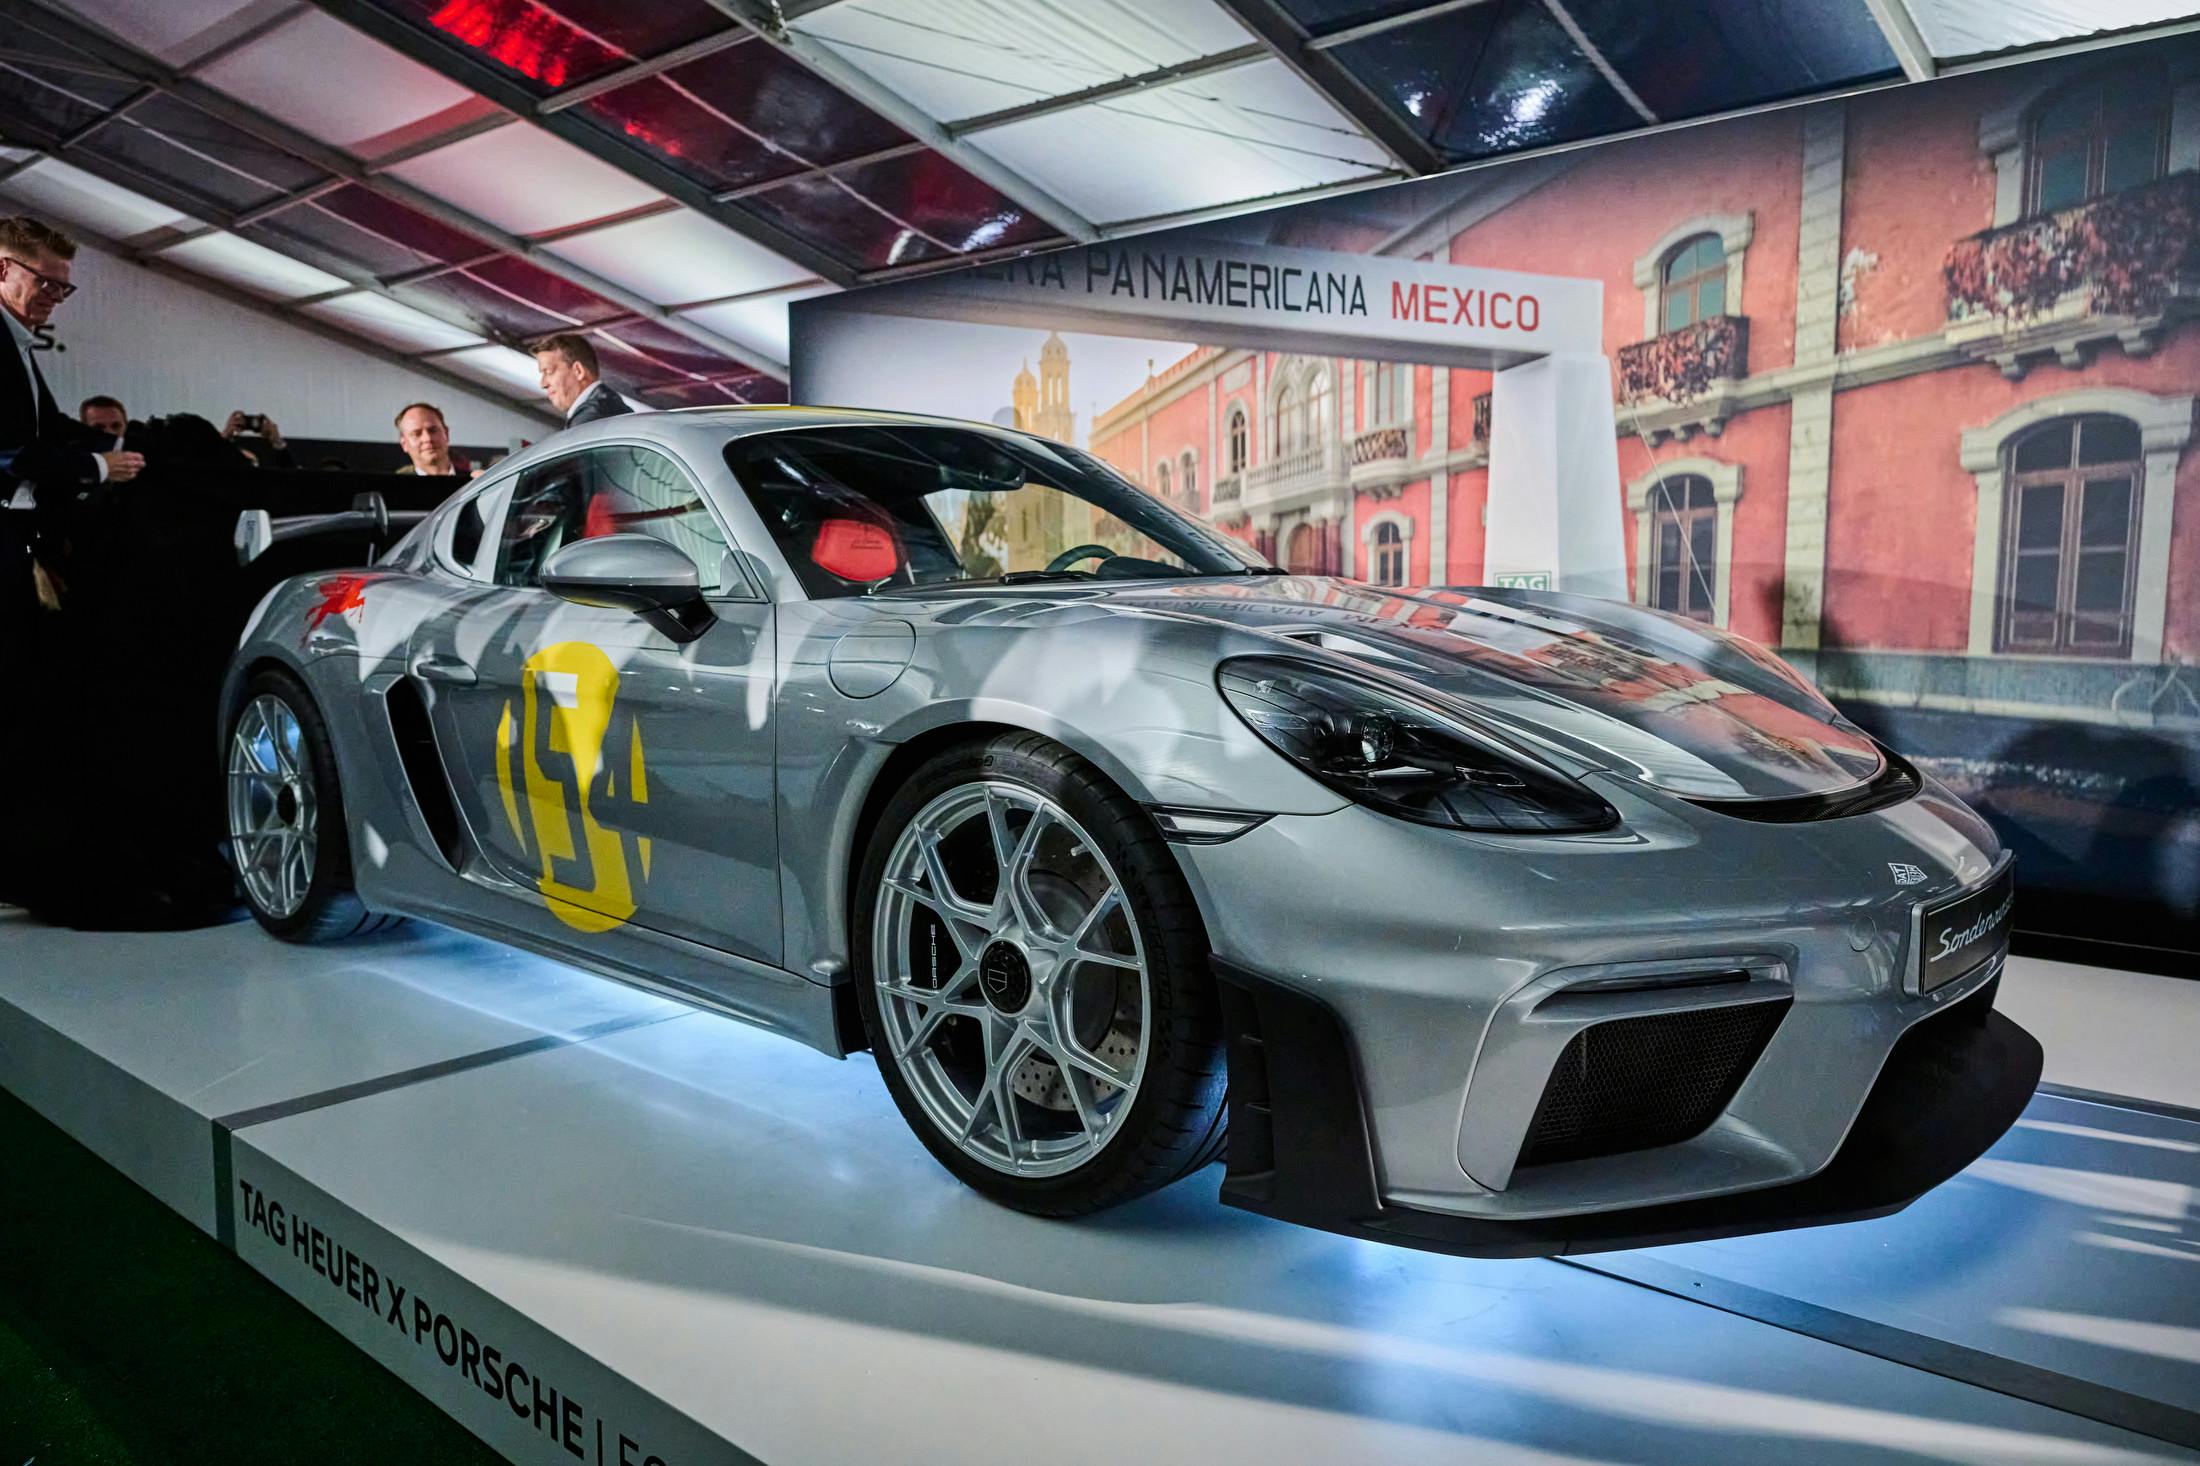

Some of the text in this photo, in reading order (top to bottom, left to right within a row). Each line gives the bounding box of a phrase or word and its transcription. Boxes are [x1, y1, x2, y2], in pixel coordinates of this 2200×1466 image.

[1086, 244, 1368, 316] PANAMERICANA
[1392, 281, 1539, 332] MEXICO
[1499, 576, 1545, 591] TAG
[930, 923, 938, 989] ORSCHE
[240, 1179, 286, 1246] TAG
[292, 1214, 381, 1316] HEUER
[386, 1276, 408, 1335] X
[414, 1296, 585, 1460] PORSCHE
